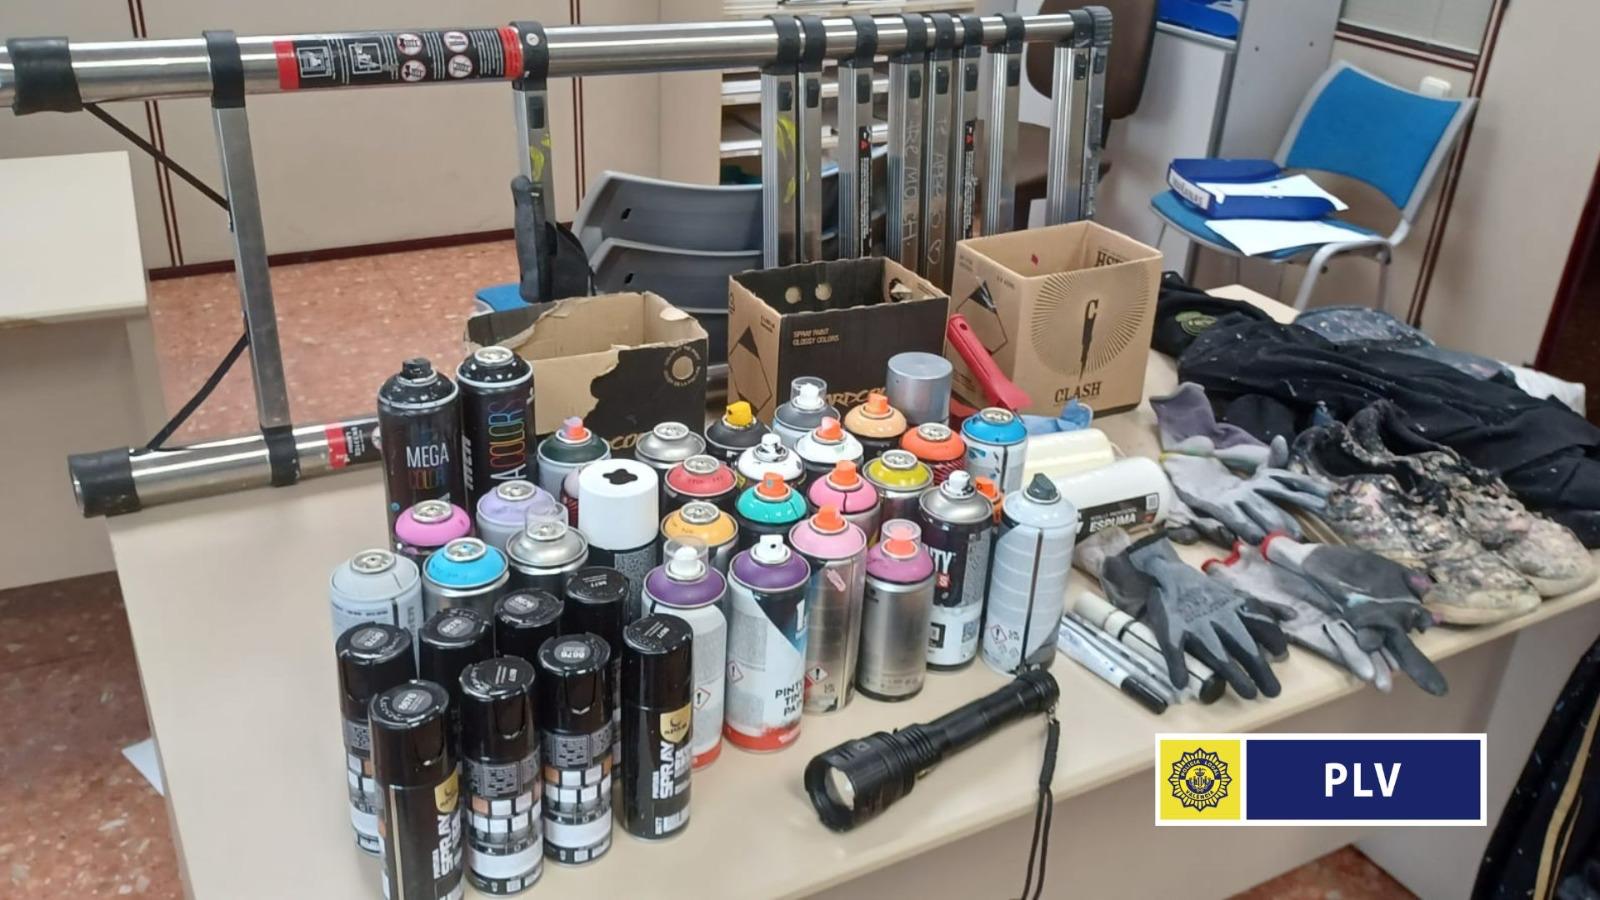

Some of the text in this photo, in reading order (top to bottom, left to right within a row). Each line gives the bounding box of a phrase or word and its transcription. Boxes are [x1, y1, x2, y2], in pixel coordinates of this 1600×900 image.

[1054, 381, 1103, 403] CLASH
[406, 442, 450, 469] MEGA
[1089, 512, 1137, 533] ESPUMA
[659, 740, 675, 800] SPRAY
[436, 814, 455, 877] SPRAY
